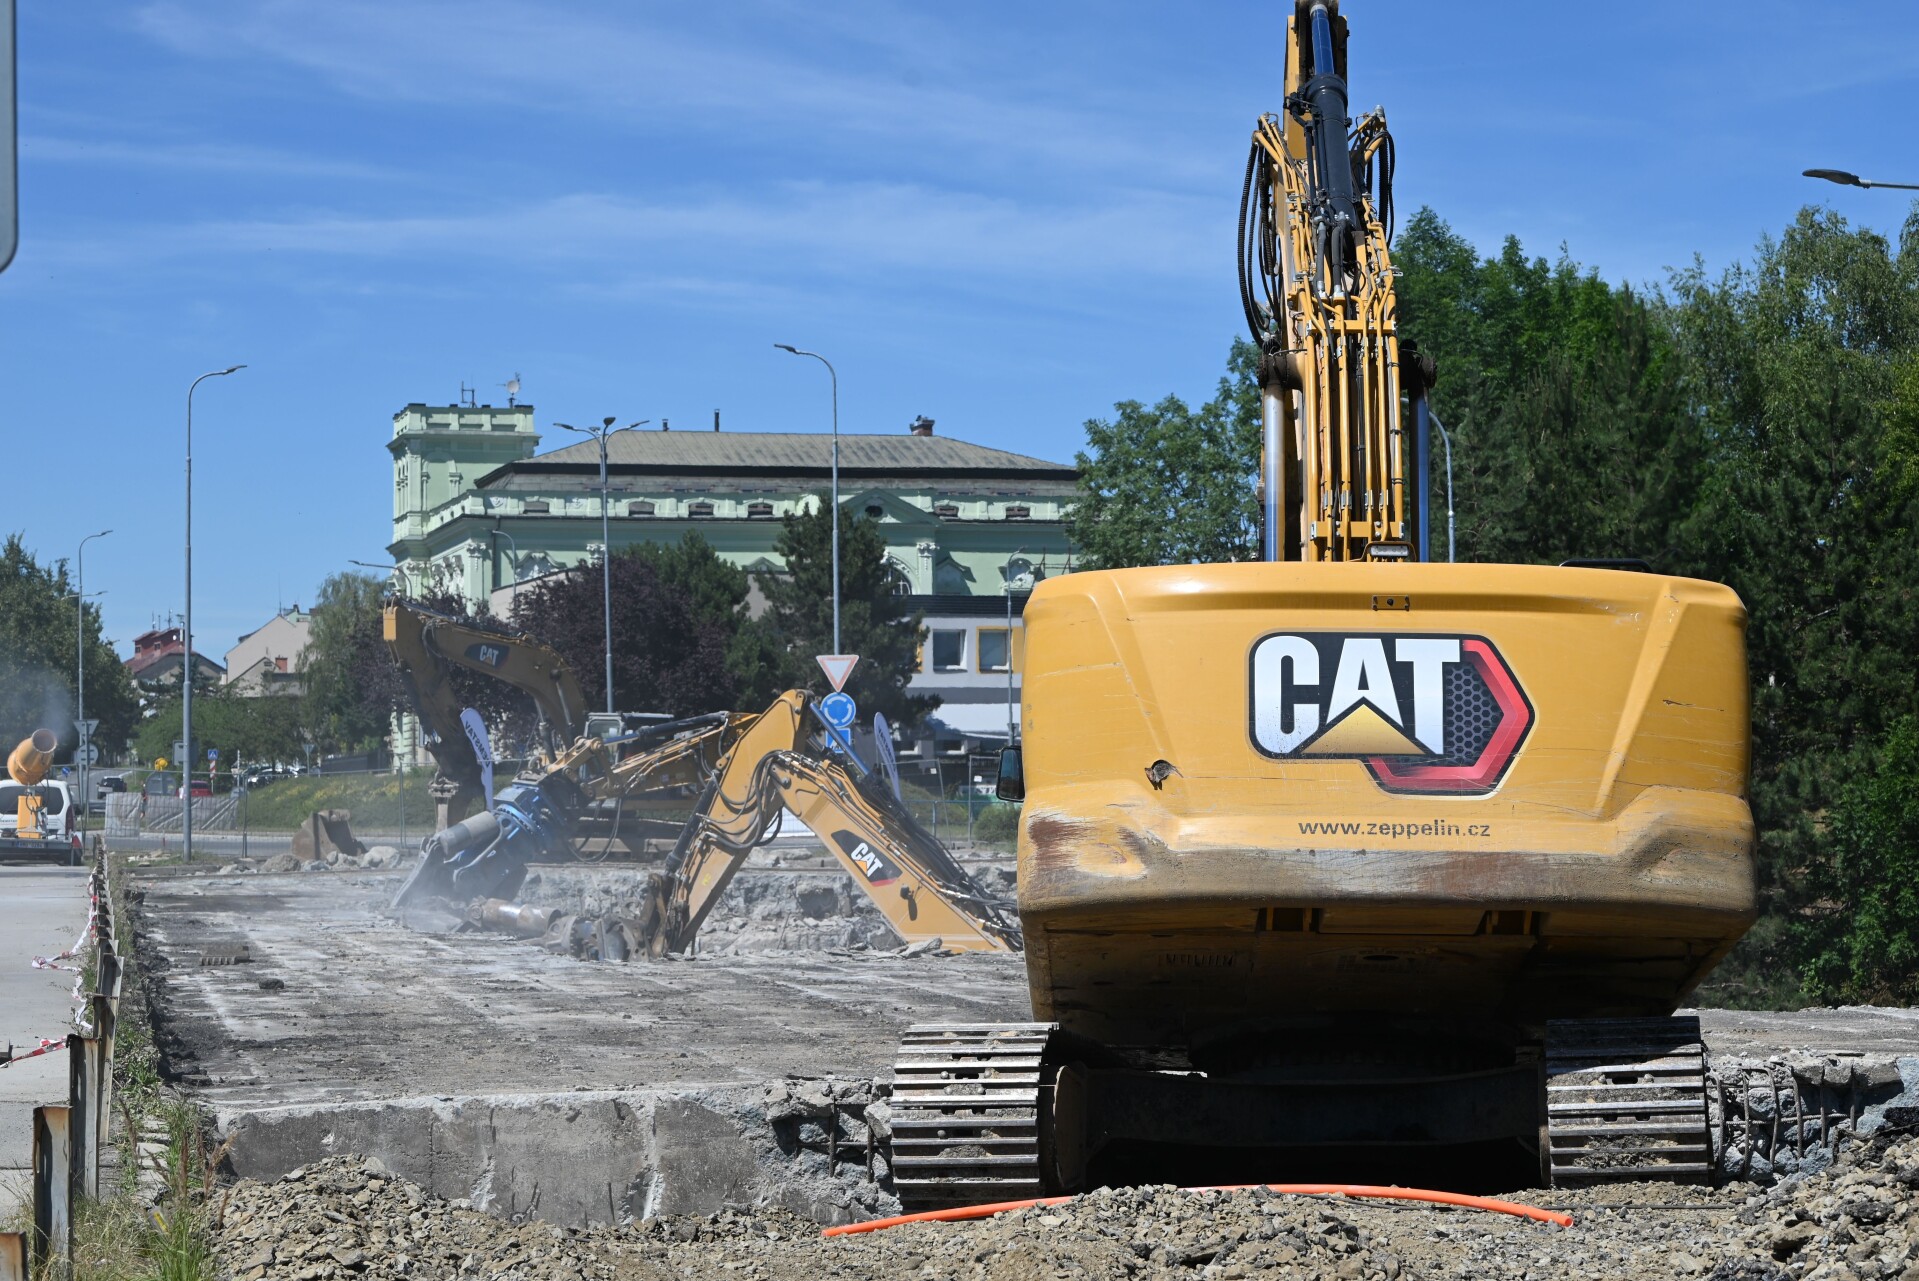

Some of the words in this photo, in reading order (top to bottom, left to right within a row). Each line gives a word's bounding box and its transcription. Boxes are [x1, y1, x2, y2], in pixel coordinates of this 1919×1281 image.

[479, 645, 499, 666] CAT
[1254, 635, 1460, 755] CAT
[1298, 819, 1491, 839] www.zeppelin.cz
[850, 842, 884, 878] CAT
